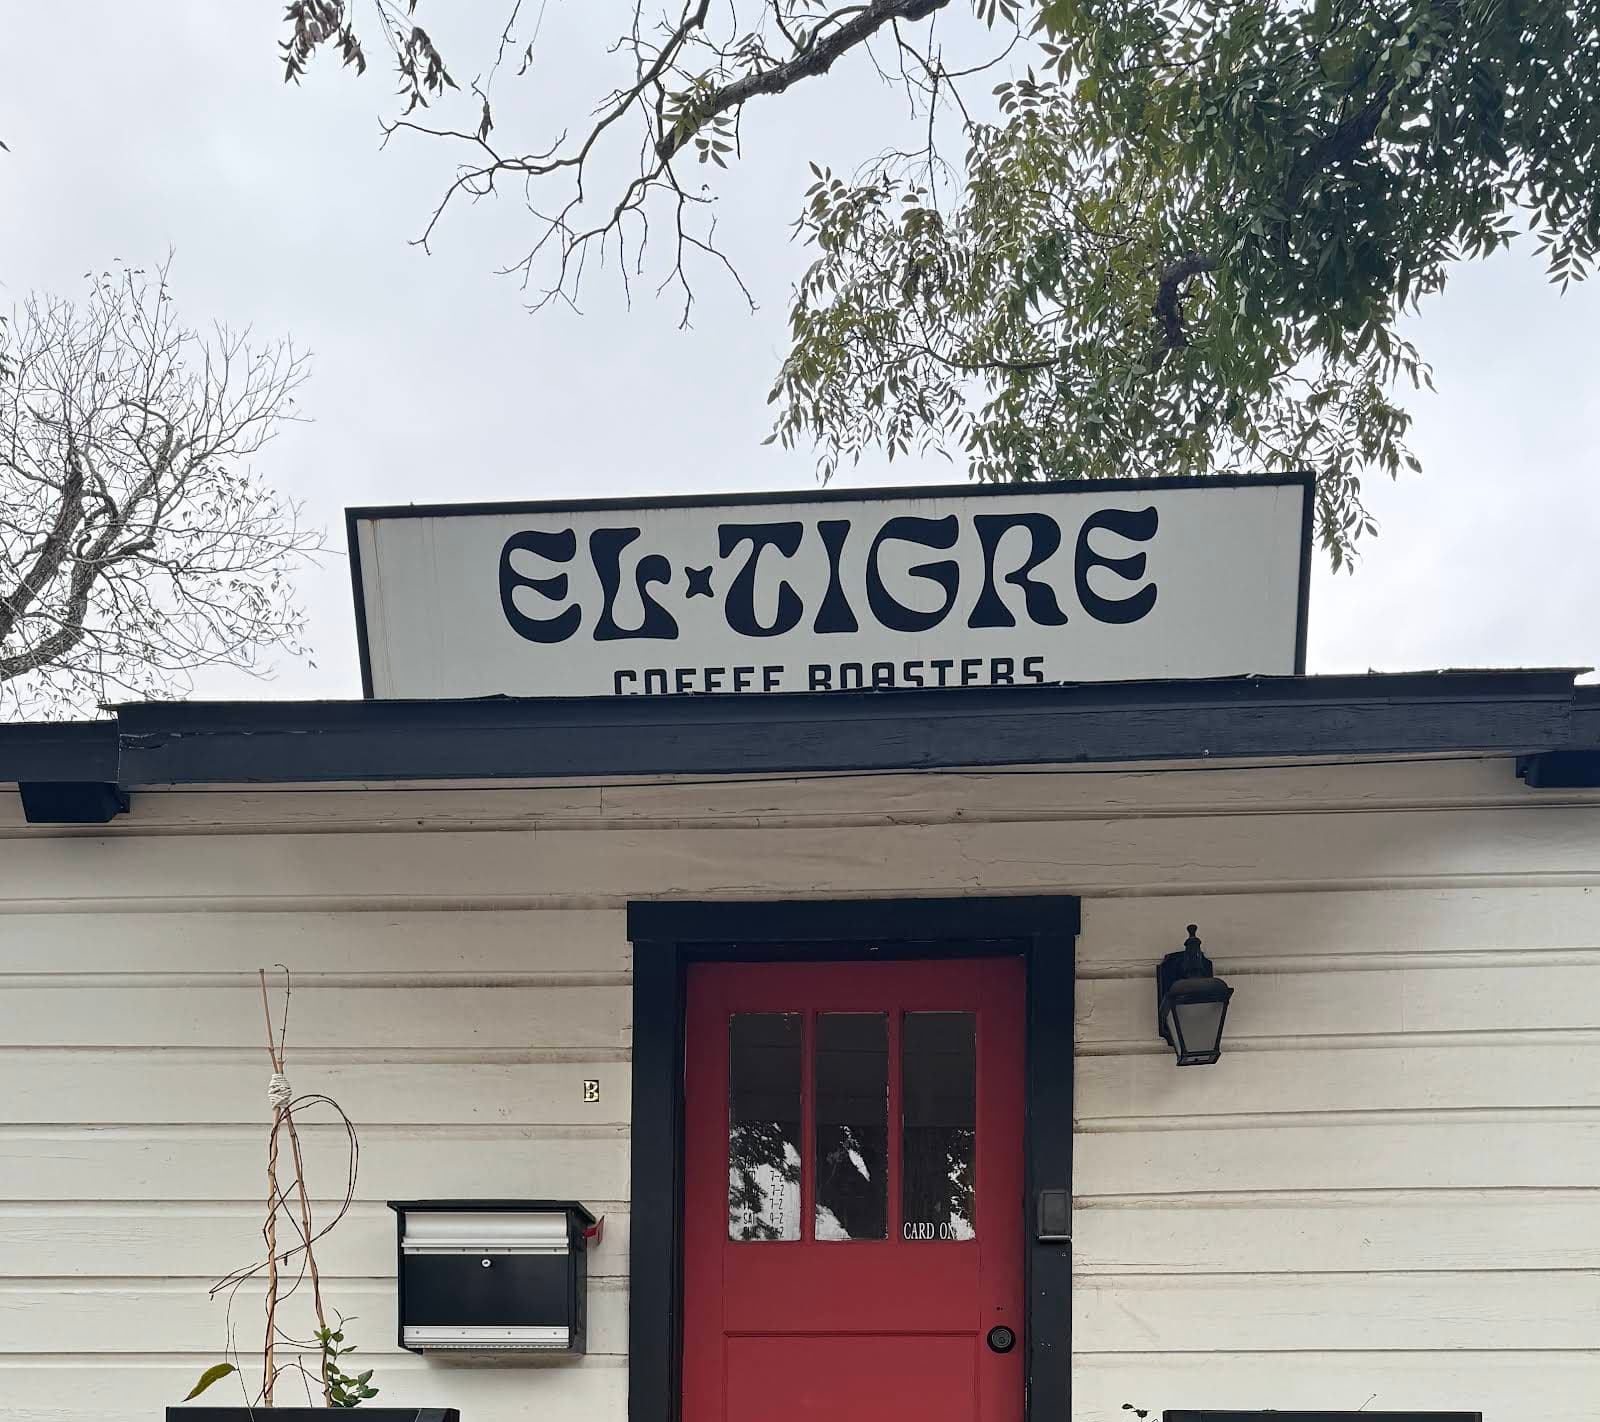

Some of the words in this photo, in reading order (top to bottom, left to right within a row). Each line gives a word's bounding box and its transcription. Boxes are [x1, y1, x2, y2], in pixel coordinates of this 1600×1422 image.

[499, 527, 680, 644] EL
[718, 506, 1159, 638] TIGRE
[614, 665, 786, 695] COFFEE
[808, 656, 1045, 691] ROASTERS
[584, 1080, 599, 1102] B
[904, 1222, 935, 1240] CARD
